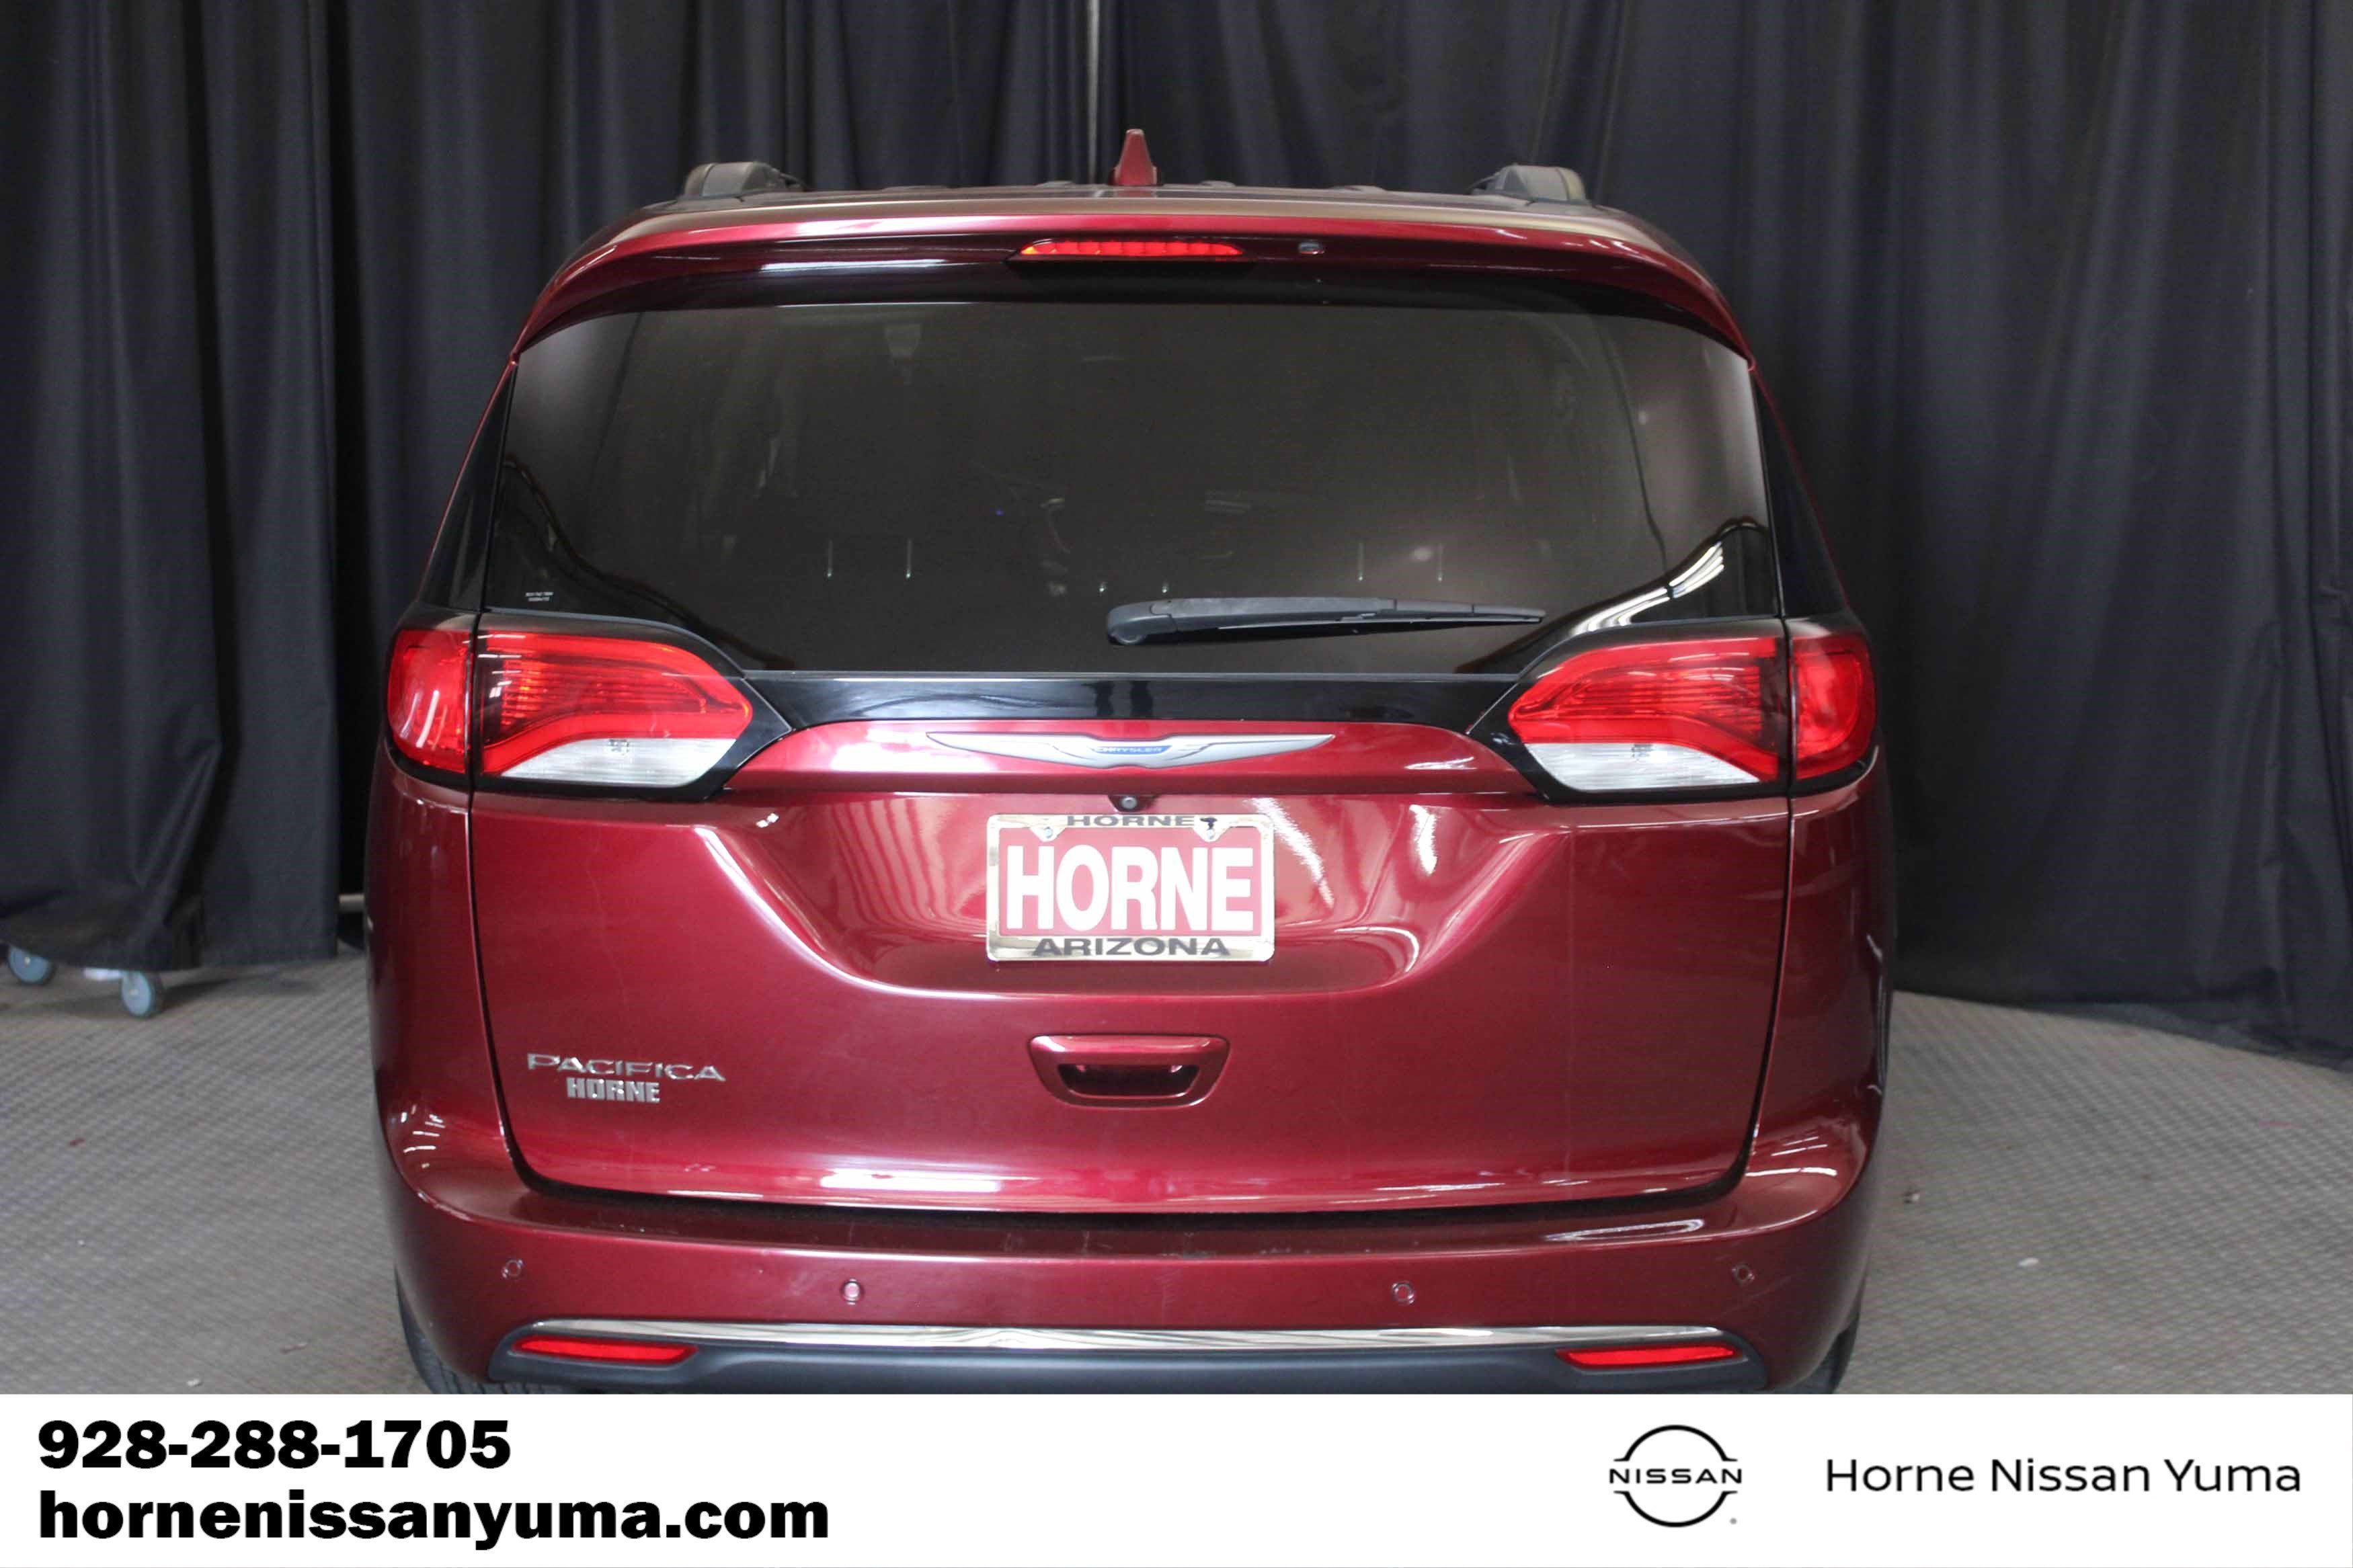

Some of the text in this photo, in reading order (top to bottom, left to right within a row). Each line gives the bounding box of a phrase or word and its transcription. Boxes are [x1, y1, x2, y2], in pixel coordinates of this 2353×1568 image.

[1067, 815, 1195, 827] HORNE
[1006, 844, 1254, 932] HORNE
[1031, 938, 1232, 956] ARIZONA
[526, 1053, 727, 1082] PACIFICA
[566, 1077, 660, 1103] HORNE
